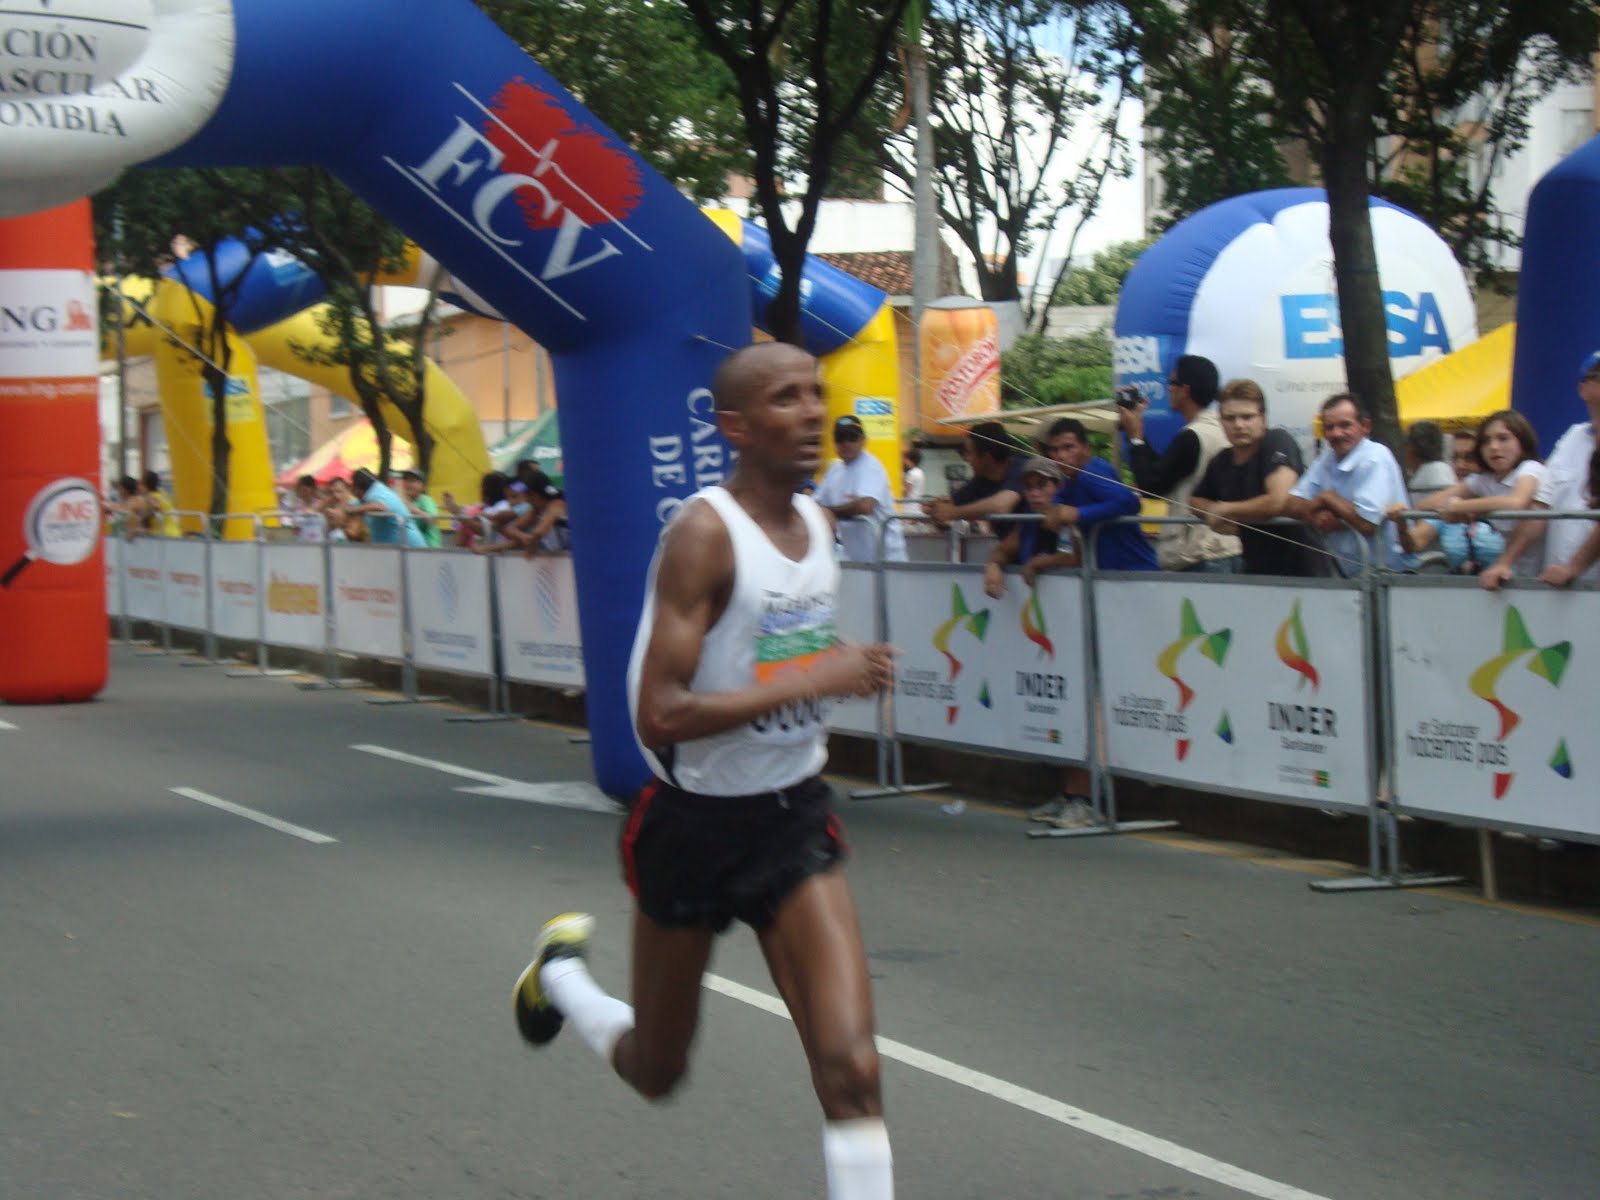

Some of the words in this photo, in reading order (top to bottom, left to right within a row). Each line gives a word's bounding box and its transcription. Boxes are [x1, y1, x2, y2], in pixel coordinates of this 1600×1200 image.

[0, 23, 97, 62] CIÓN
[407, 114, 623, 281] FCV
[649, 435, 687, 489] DE
[1016, 670, 1068, 700] INDER
[1267, 702, 1337, 738] INDER
